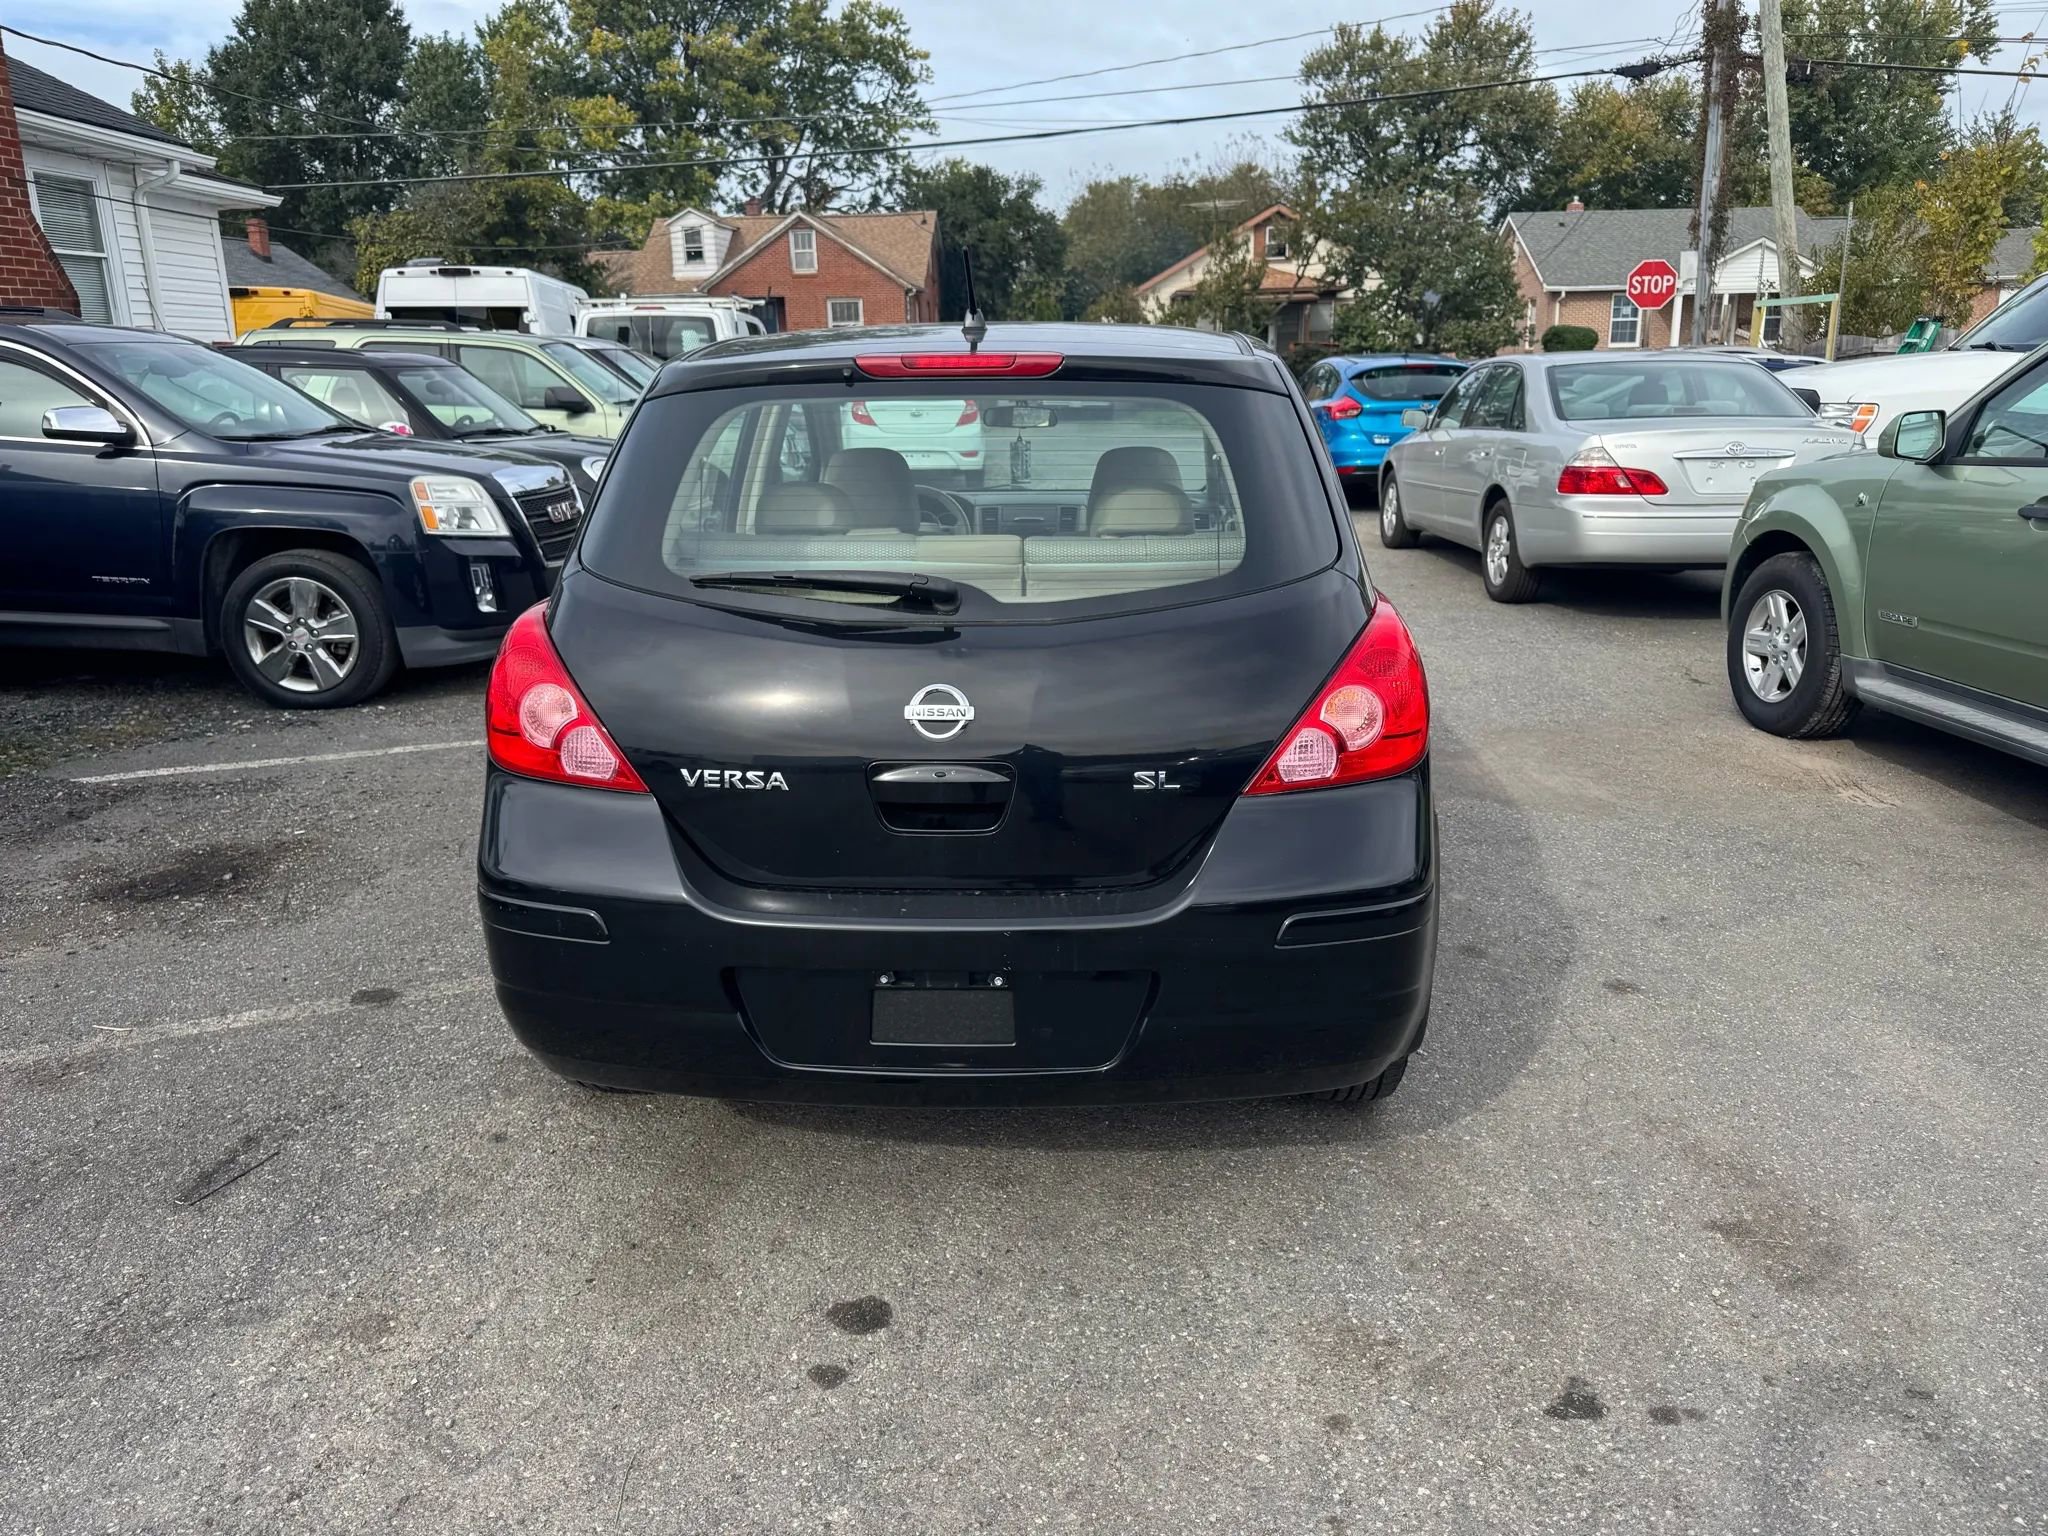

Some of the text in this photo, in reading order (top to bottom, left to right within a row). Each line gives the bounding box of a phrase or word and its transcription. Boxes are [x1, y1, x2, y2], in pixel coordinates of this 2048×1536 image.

[1630, 275, 1674, 294] STOP
[911, 707, 967, 717] NISSAN
[680, 768, 789, 791] VERSA
[1133, 771, 1181, 790] SL
